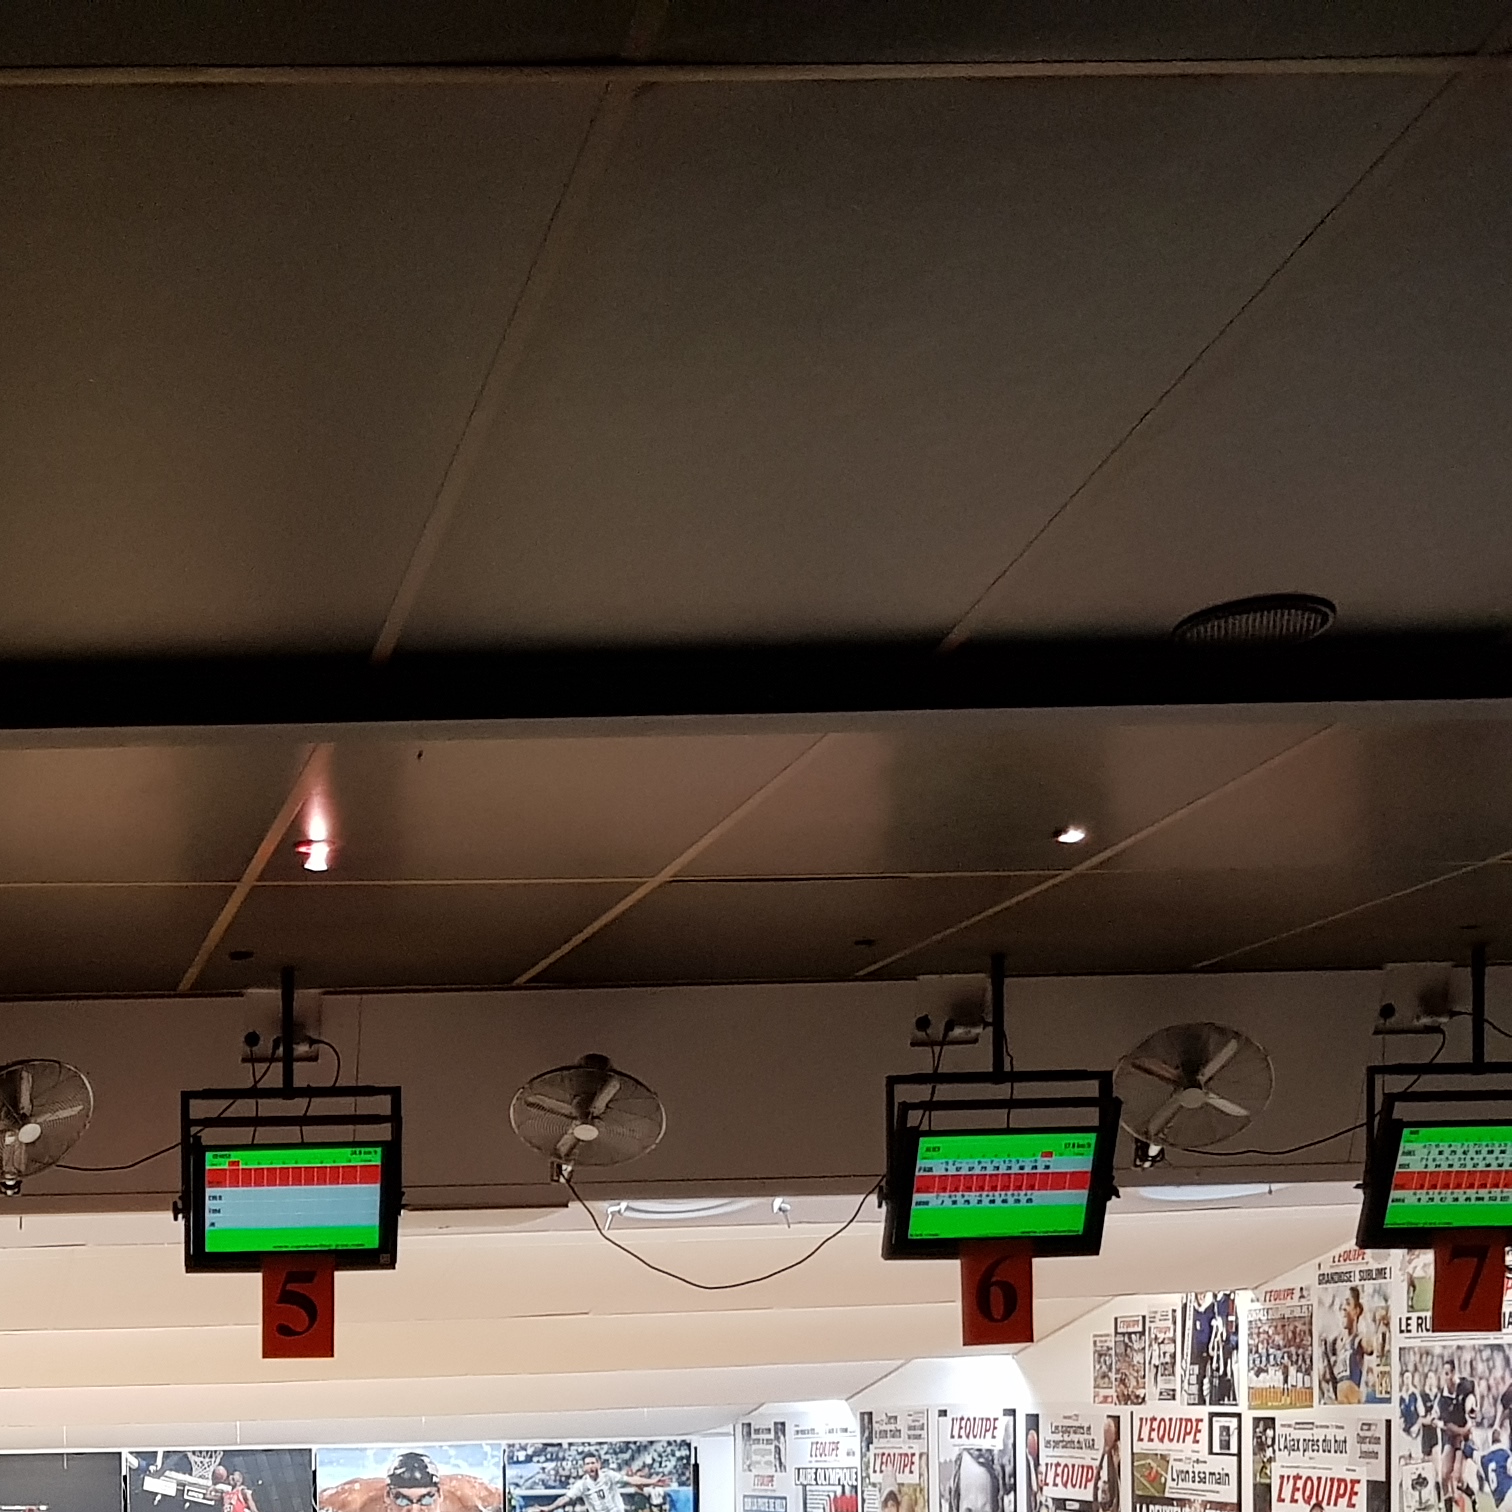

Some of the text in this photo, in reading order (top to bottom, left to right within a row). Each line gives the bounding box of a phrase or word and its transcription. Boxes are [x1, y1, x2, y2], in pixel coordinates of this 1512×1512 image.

[975, 1255, 1019, 1323] 6
[1447, 1244, 1491, 1312] 7
[275, 1270, 318, 1338] 5
[1399, 1316, 1412, 1333] LE
[1050, 1423, 1060, 1434] Les
[1061, 1424, 1085, 1437] gagnants
[1052, 1438, 1076, 1451] perdants
[1077, 1438, 1083, 1449] du
[1277, 1433, 1347, 1457] L'Ajax près du but
[795, 1468, 858, 1486] LAURE OLYMPIQUE
[1044, 1461, 1094, 1490] L'ÉQUIP
[1171, 1464, 1190, 1487] Lyon
[1197, 1468, 1207, 1484] sa
[1208, 1466, 1230, 1486] main
